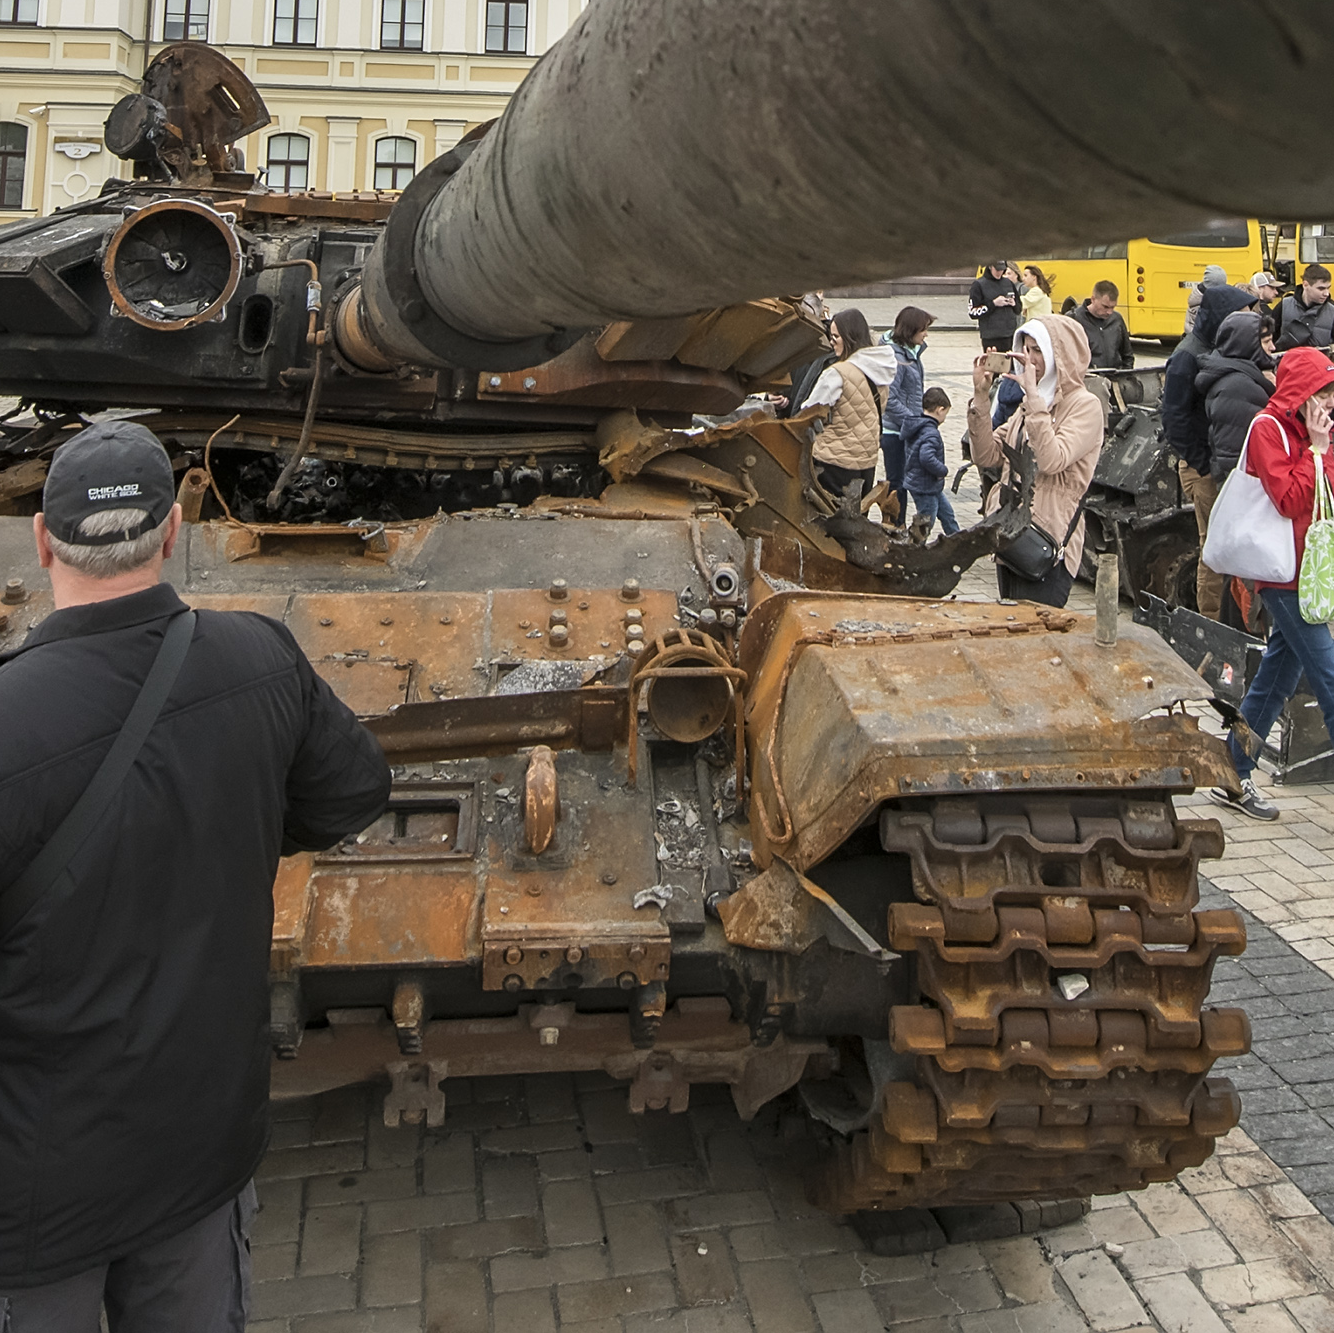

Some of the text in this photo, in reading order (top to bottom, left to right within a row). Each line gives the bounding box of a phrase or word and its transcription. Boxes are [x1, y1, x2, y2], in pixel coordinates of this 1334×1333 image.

[73, 147, 83, 156] 2
[88, 483, 139, 496] CHICAGO
[89, 491, 119, 501] WHITE
